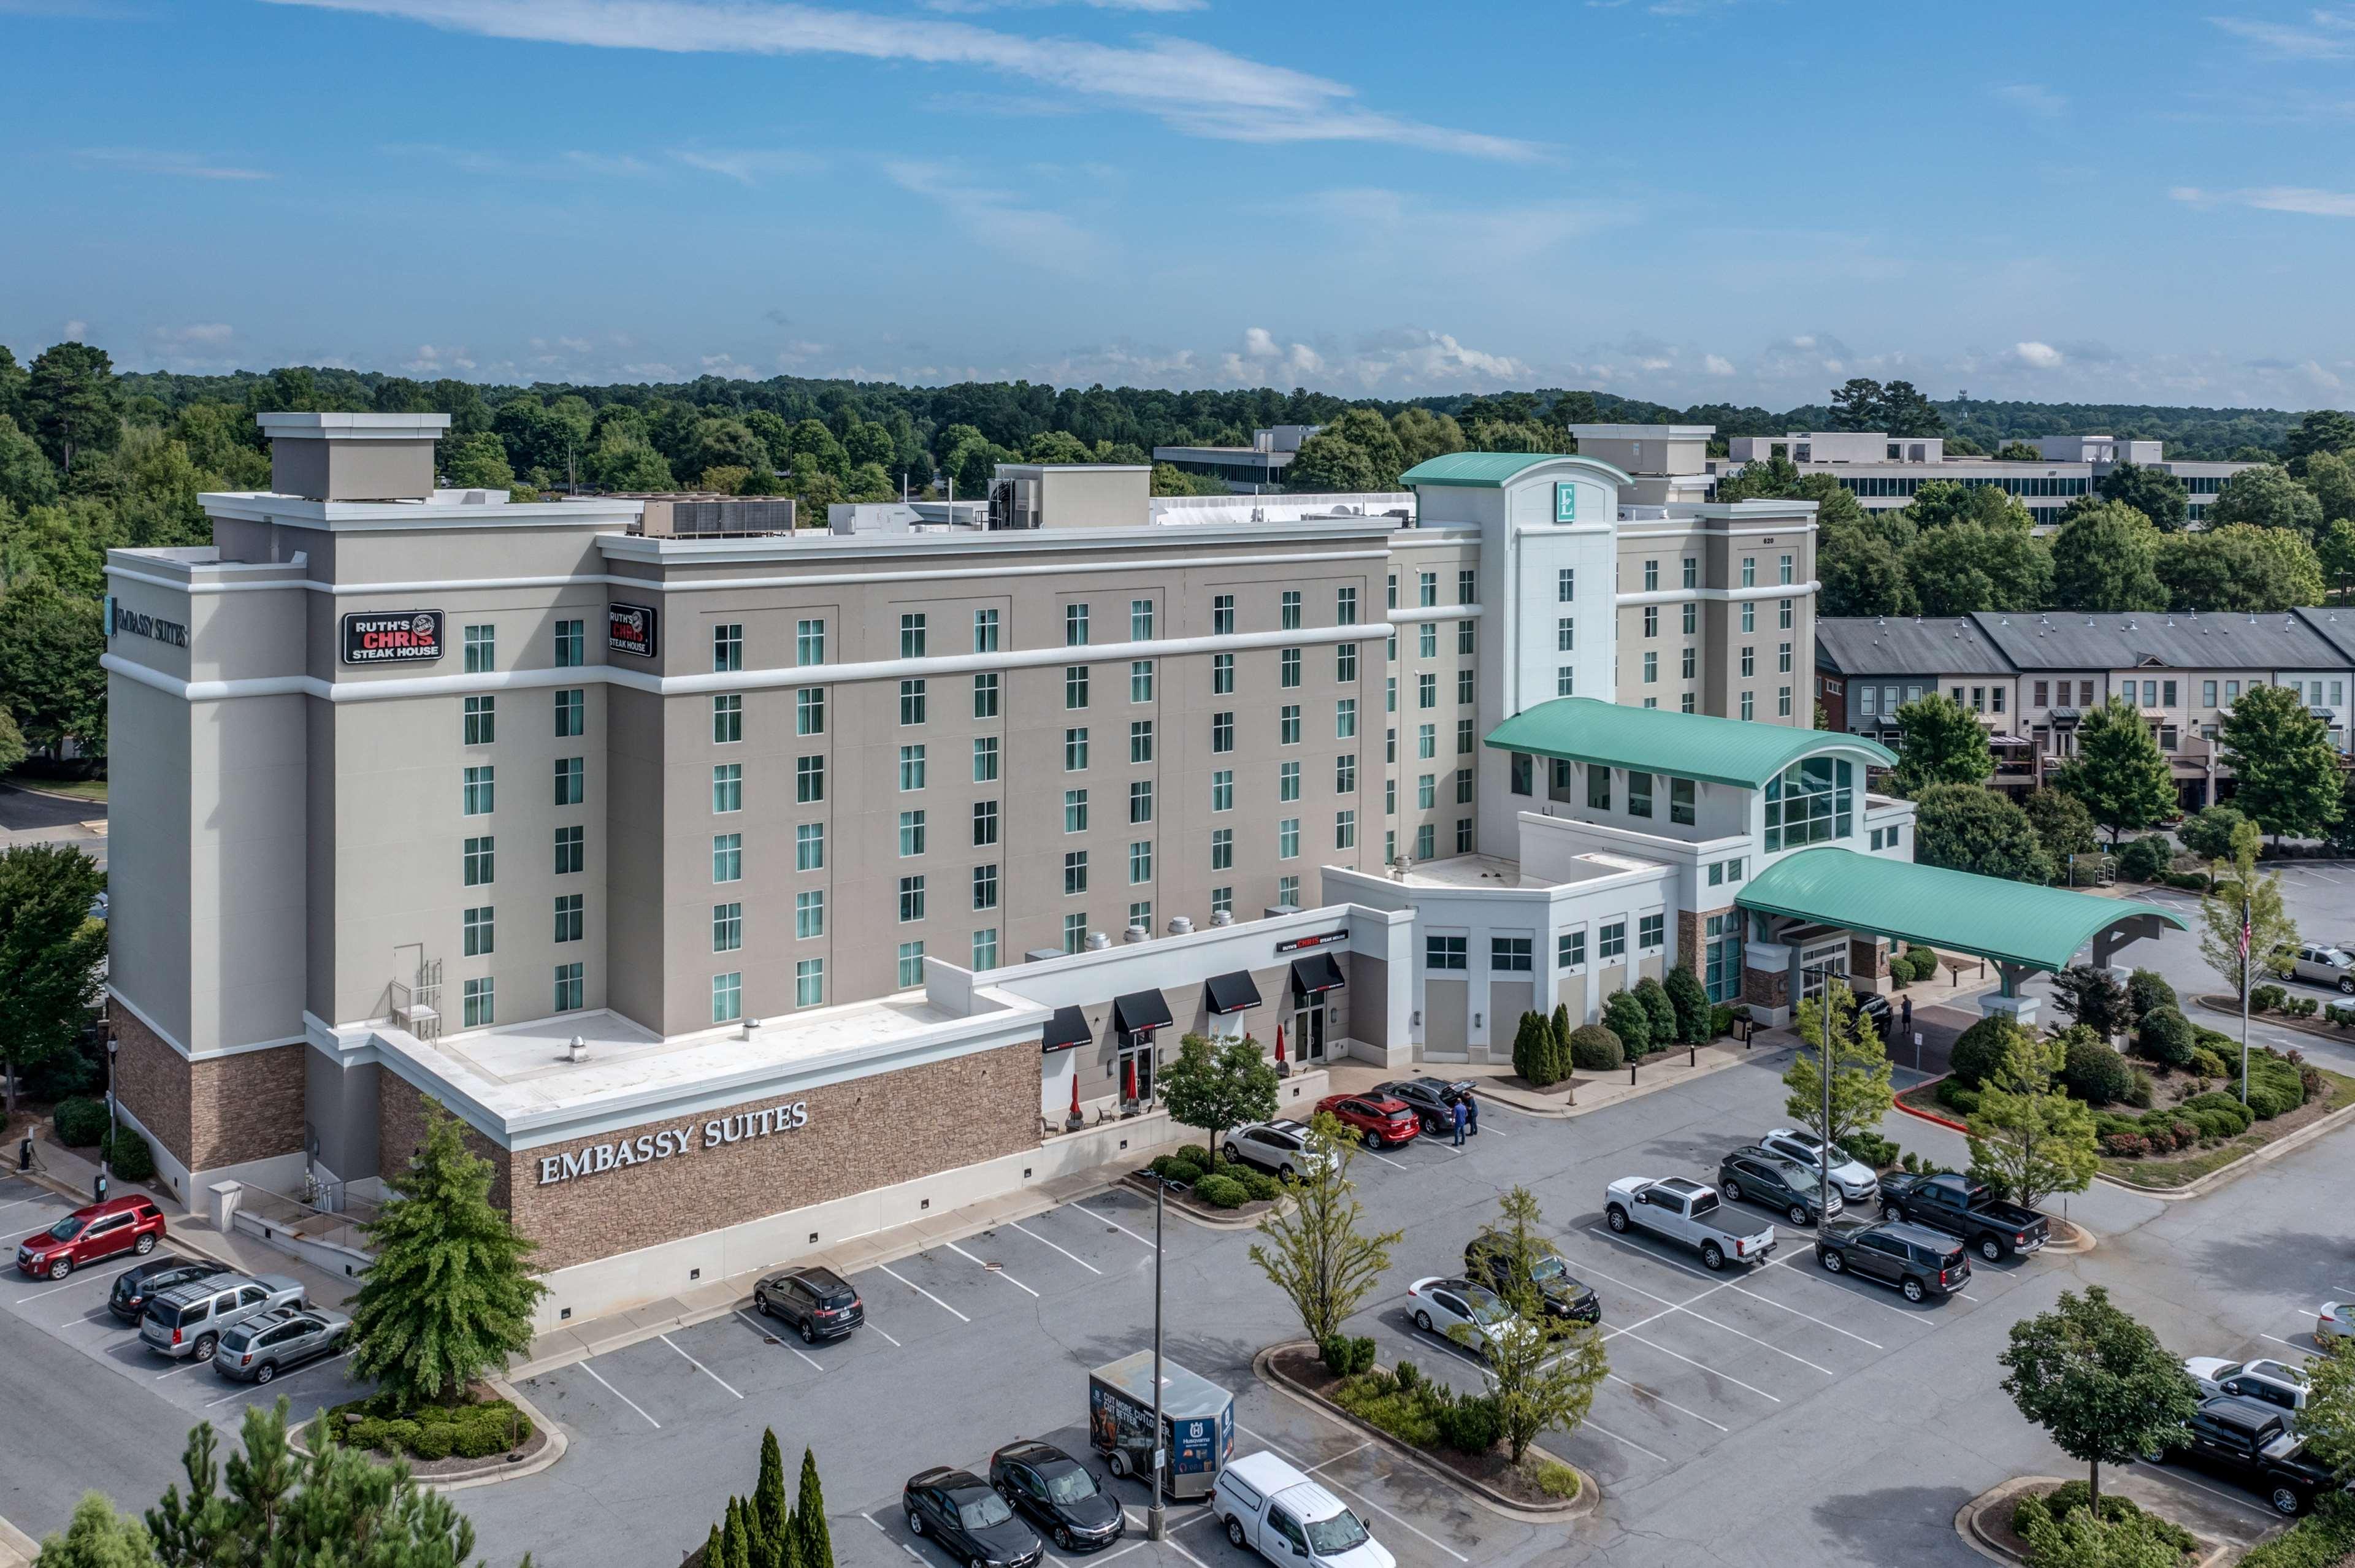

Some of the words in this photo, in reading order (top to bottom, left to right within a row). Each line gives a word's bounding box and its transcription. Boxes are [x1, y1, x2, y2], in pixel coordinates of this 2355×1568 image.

[1560, 489, 1572, 515] E
[610, 612, 633, 624] RUTH'S
[118, 608, 153, 638] EMBASSY
[156, 618, 188, 648] SUITES
[356, 621, 410, 632] RUTH'S
[364, 632, 434, 649] CHRIS
[609, 638, 626, 648] STEAK
[627, 641, 645, 652] HOUSE
[353, 648, 394, 659] STEAK
[397, 646, 438, 657] HOUSE
[1297, 936, 1320, 948] CHRIS
[539, 1126, 694, 1185] EMBASSY
[705, 1101, 808, 1147] SUITES
[1103, 1402, 1115, 1414] CUT
[1103, 1392, 1115, 1404] CUT
[1134, 1409, 1146, 1423] CUT
[1146, 1417, 1171, 1437] LOER.
